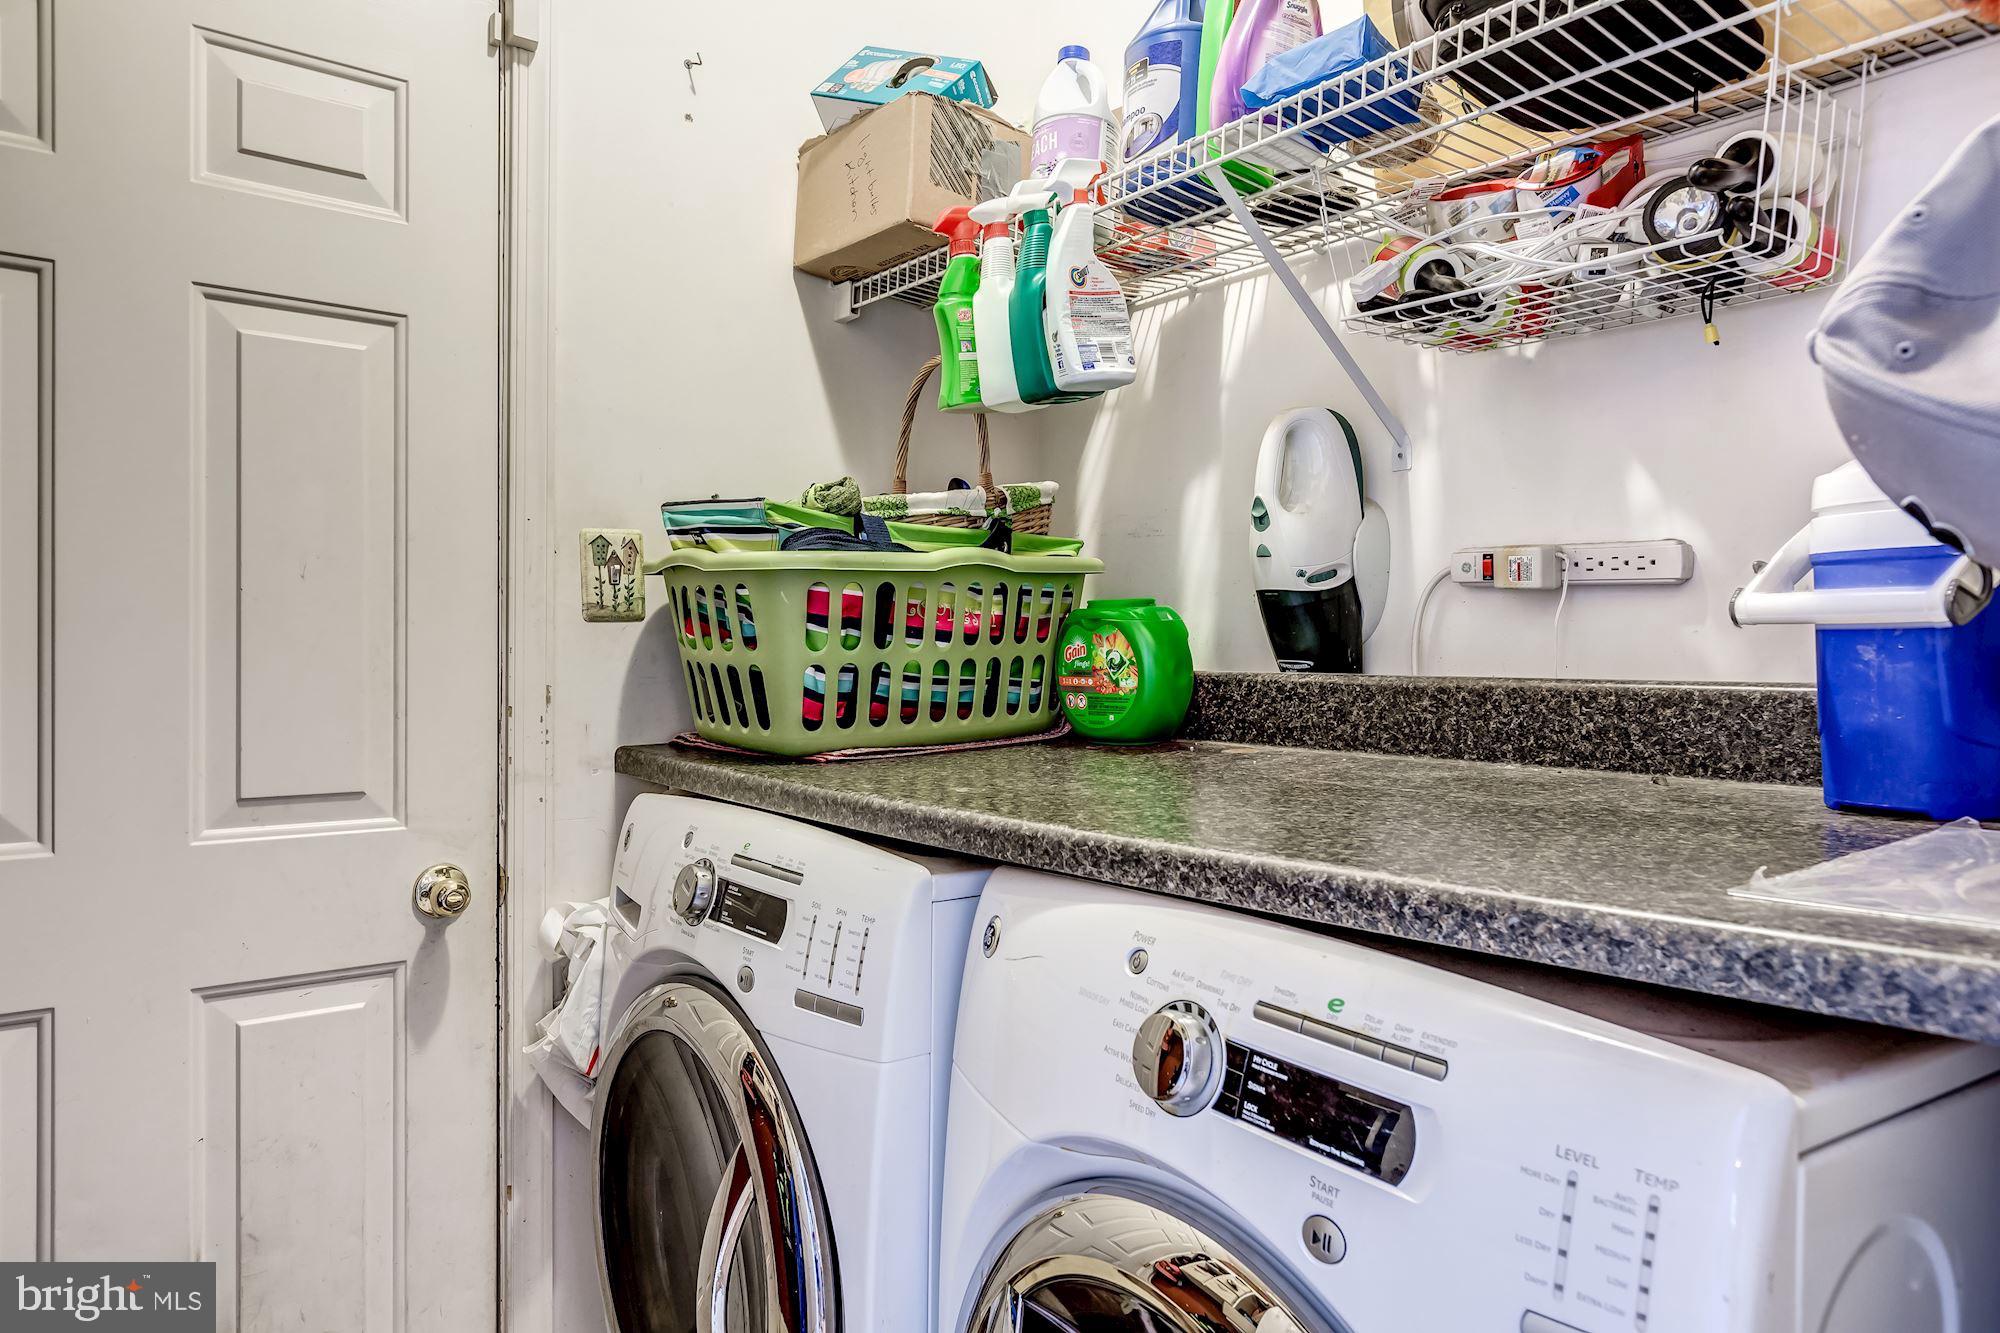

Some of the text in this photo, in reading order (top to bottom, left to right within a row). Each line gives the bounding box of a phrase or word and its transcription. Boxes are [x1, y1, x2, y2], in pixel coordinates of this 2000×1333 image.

[1064, 641, 1087, 663] Gain
[1132, 930, 1157, 947] POWER
[742, 946, 755, 957] START
[1327, 998, 1346, 1013] e
[1420, 1030, 1458, 1048] EXTENDED
[1128, 1099, 1145, 1114] SPEED
[1243, 1100, 1259, 1114] LOCK
[1555, 1144, 1600, 1169] LEVEL
[1309, 1175, 1341, 1198] START
[1634, 1168, 1680, 1193] TEMP
[1312, 1191, 1334, 1208] PAUSE
